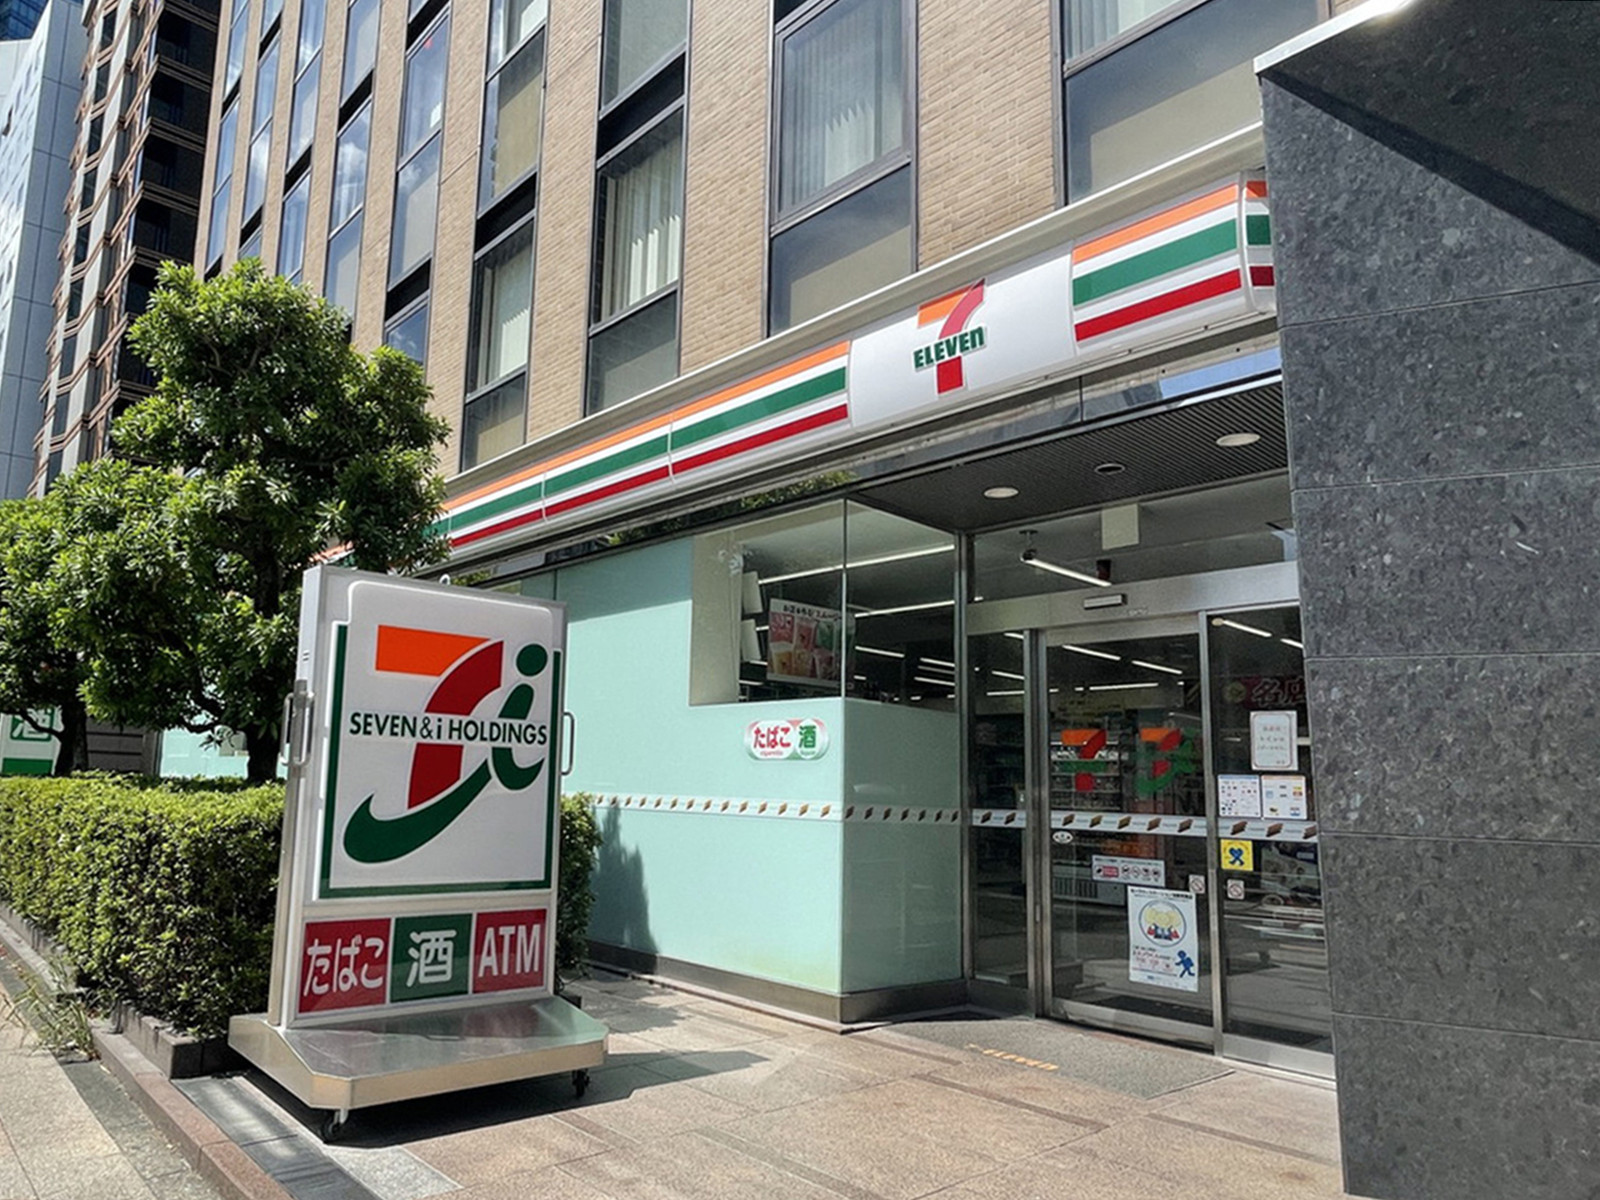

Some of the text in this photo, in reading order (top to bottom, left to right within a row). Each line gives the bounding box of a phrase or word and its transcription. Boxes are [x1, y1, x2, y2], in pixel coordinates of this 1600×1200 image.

[448, 719, 547, 745] HOLDINGS
[753, 725, 817, 748] たばこ 酒
[303, 923, 542, 997] たばこ 酒 ATM
